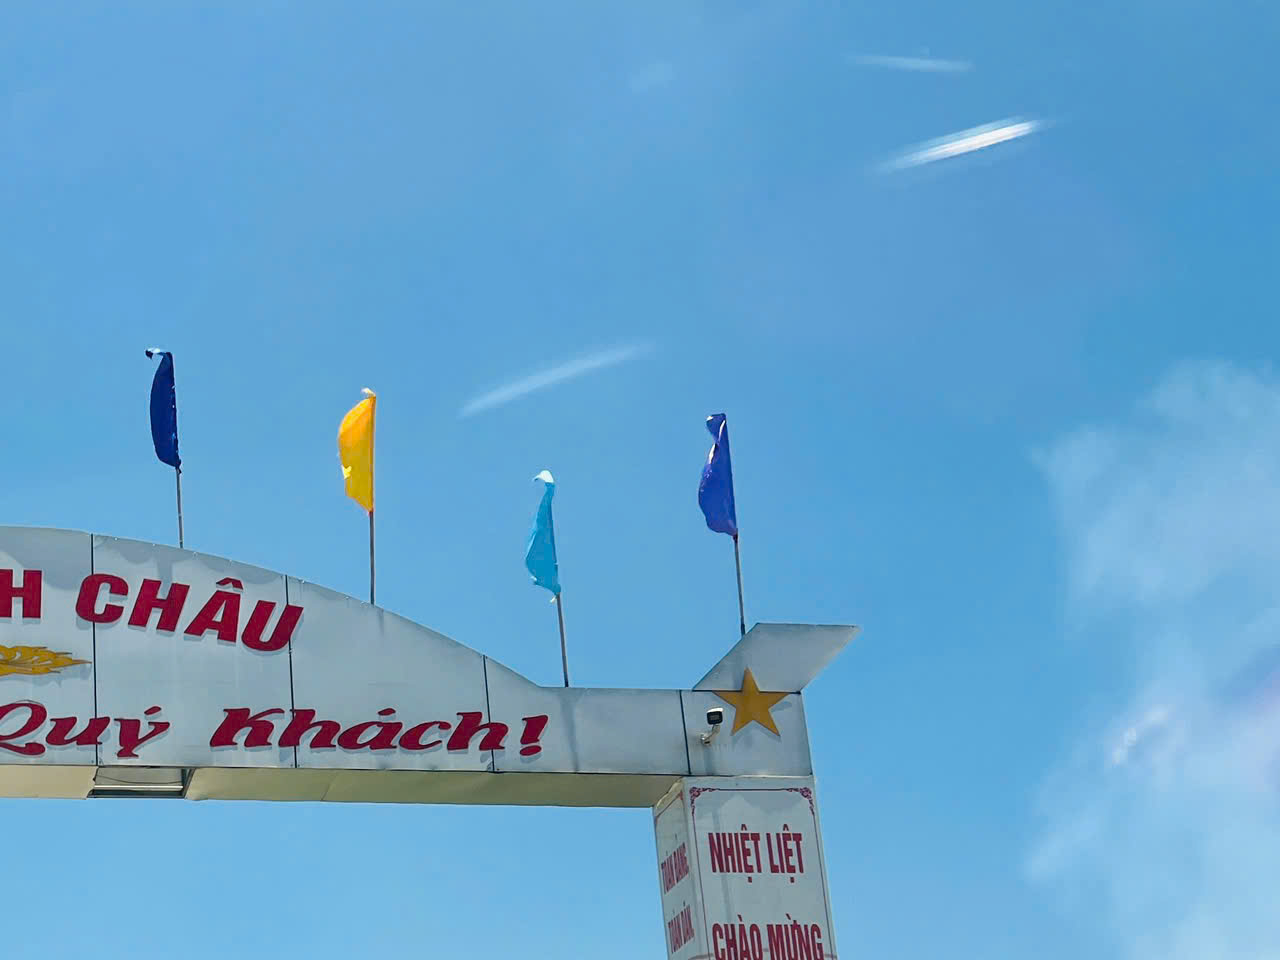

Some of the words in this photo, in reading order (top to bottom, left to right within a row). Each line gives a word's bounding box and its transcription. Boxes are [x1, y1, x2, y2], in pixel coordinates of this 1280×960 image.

[75, 573, 304, 652] CHÂU
[210, 708, 549, 756] Khách!
[708, 824, 763, 883] NHIỆT
[766, 824, 804, 883] LIỆT
